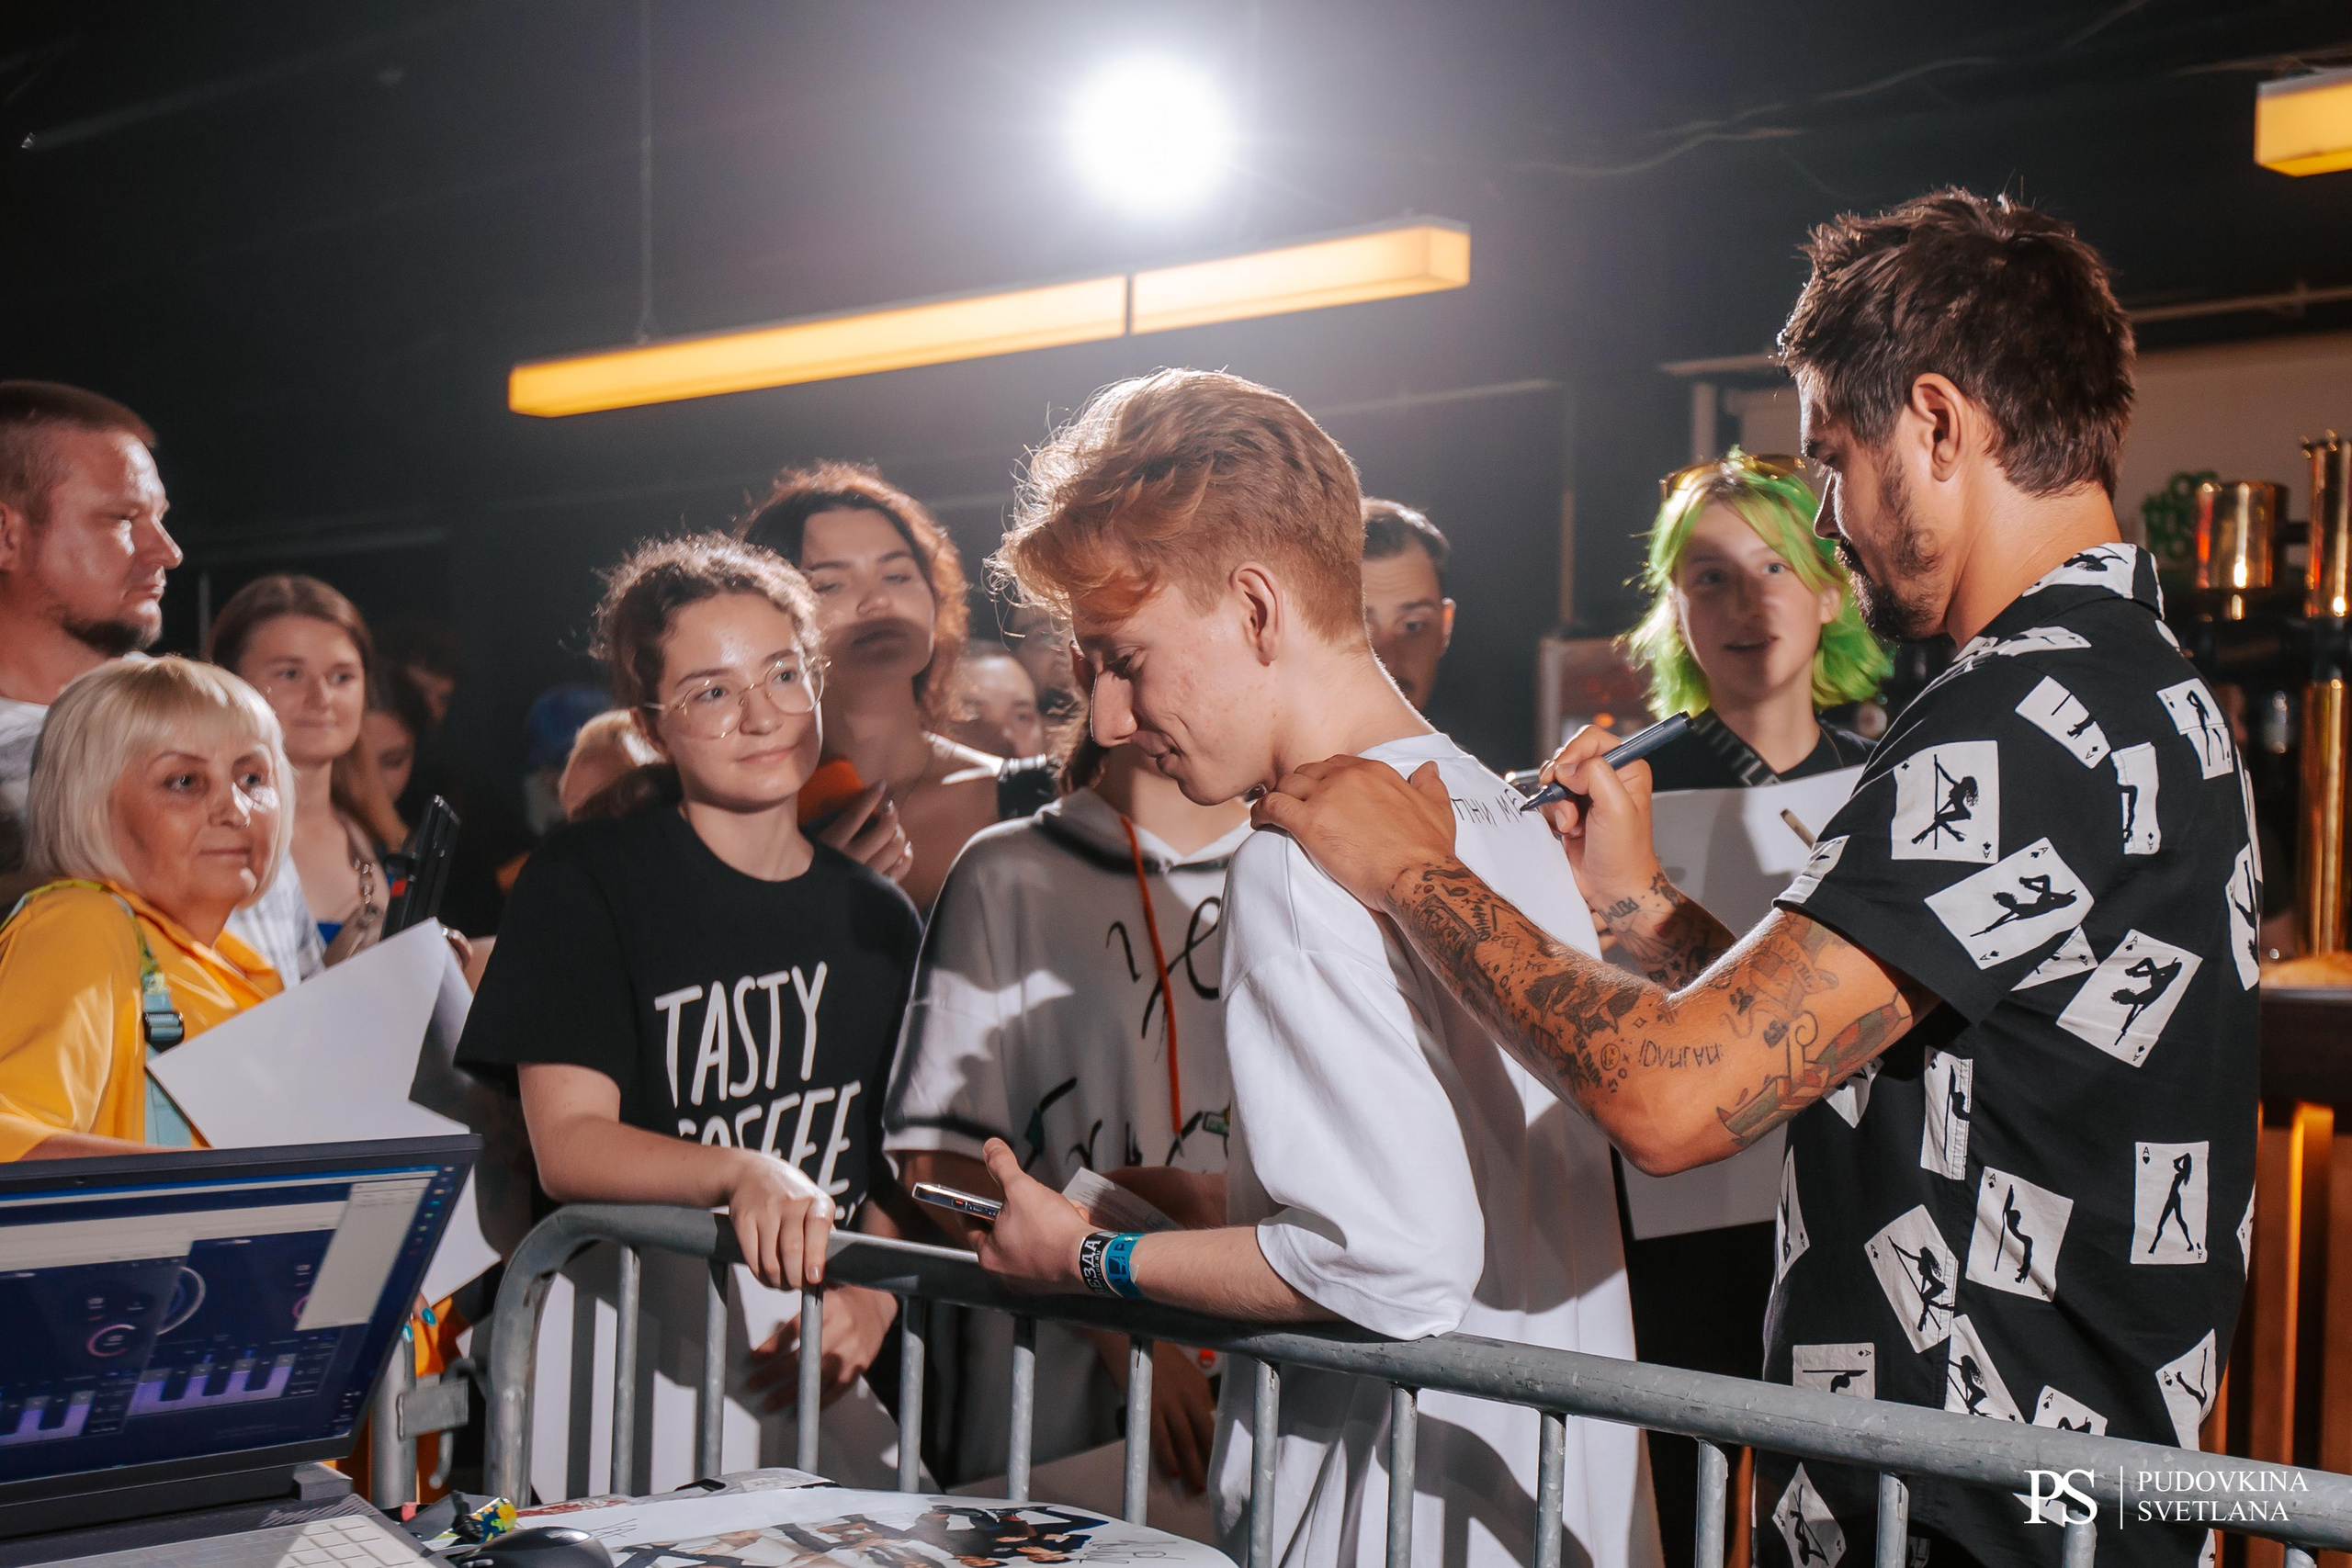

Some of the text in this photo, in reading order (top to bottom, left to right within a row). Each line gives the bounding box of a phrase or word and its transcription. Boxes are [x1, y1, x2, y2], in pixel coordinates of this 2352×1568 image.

[2086, 750, 2095, 760] A
[1983, 850, 1991, 859] A
[2039, 845, 2050, 855] A
[2131, 935, 2139, 945] A
[1979, 953, 1991, 961] A
[654, 961, 827, 1109] TASTY
[2132, 1052, 2141, 1062] A
[2143, 1146, 2151, 1156] A
[1988, 1172, 1996, 1182] A
[1864, 1349, 1872, 1358] A
[2164, 1371, 2172, 1380] A
[2046, 1392, 2054, 1402] A
